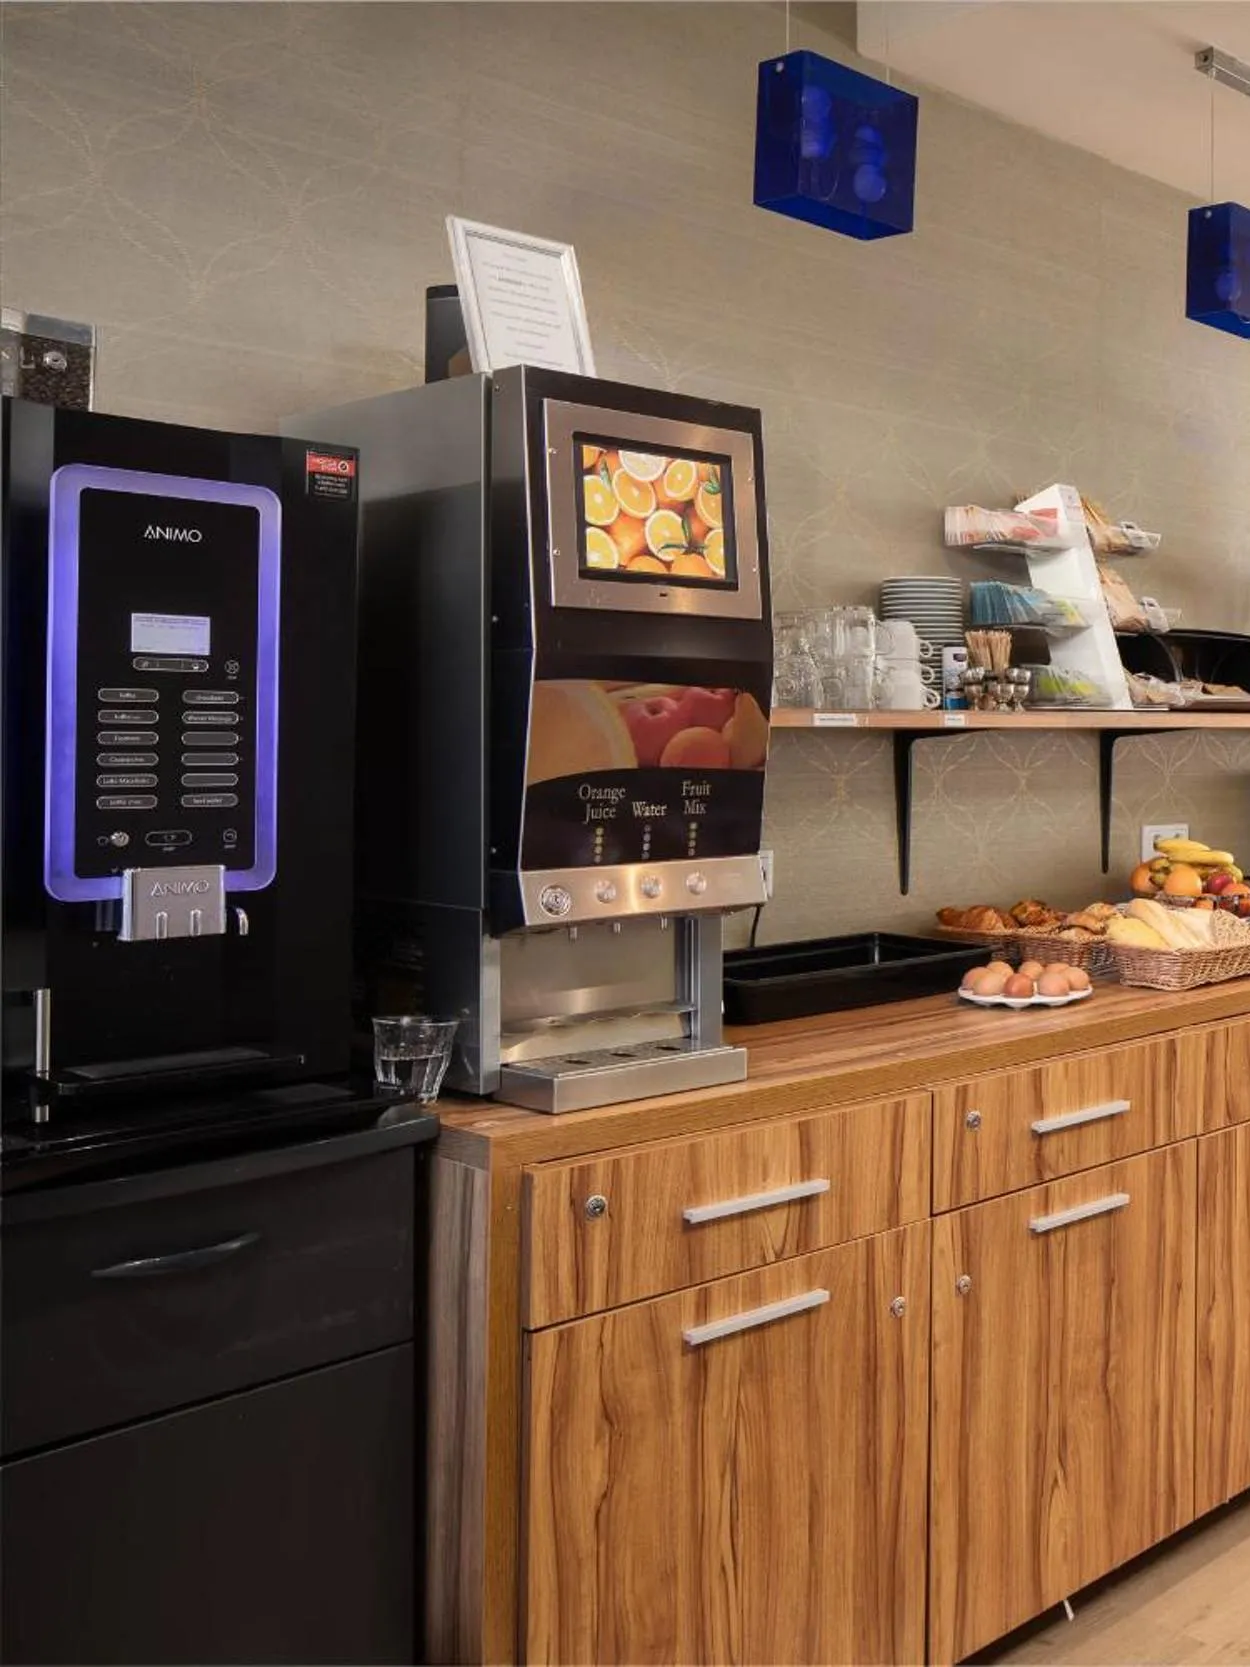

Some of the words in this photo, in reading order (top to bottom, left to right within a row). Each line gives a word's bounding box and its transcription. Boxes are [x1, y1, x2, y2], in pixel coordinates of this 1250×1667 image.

[144, 525, 203, 543] ANIMO
[579, 783, 627, 805] Orange
[681, 780, 712, 797] Fruit
[583, 801, 617, 825] Juice
[632, 800, 668, 818] Water
[684, 799, 707, 816] Mix
[151, 880, 210, 897] ANIMO
